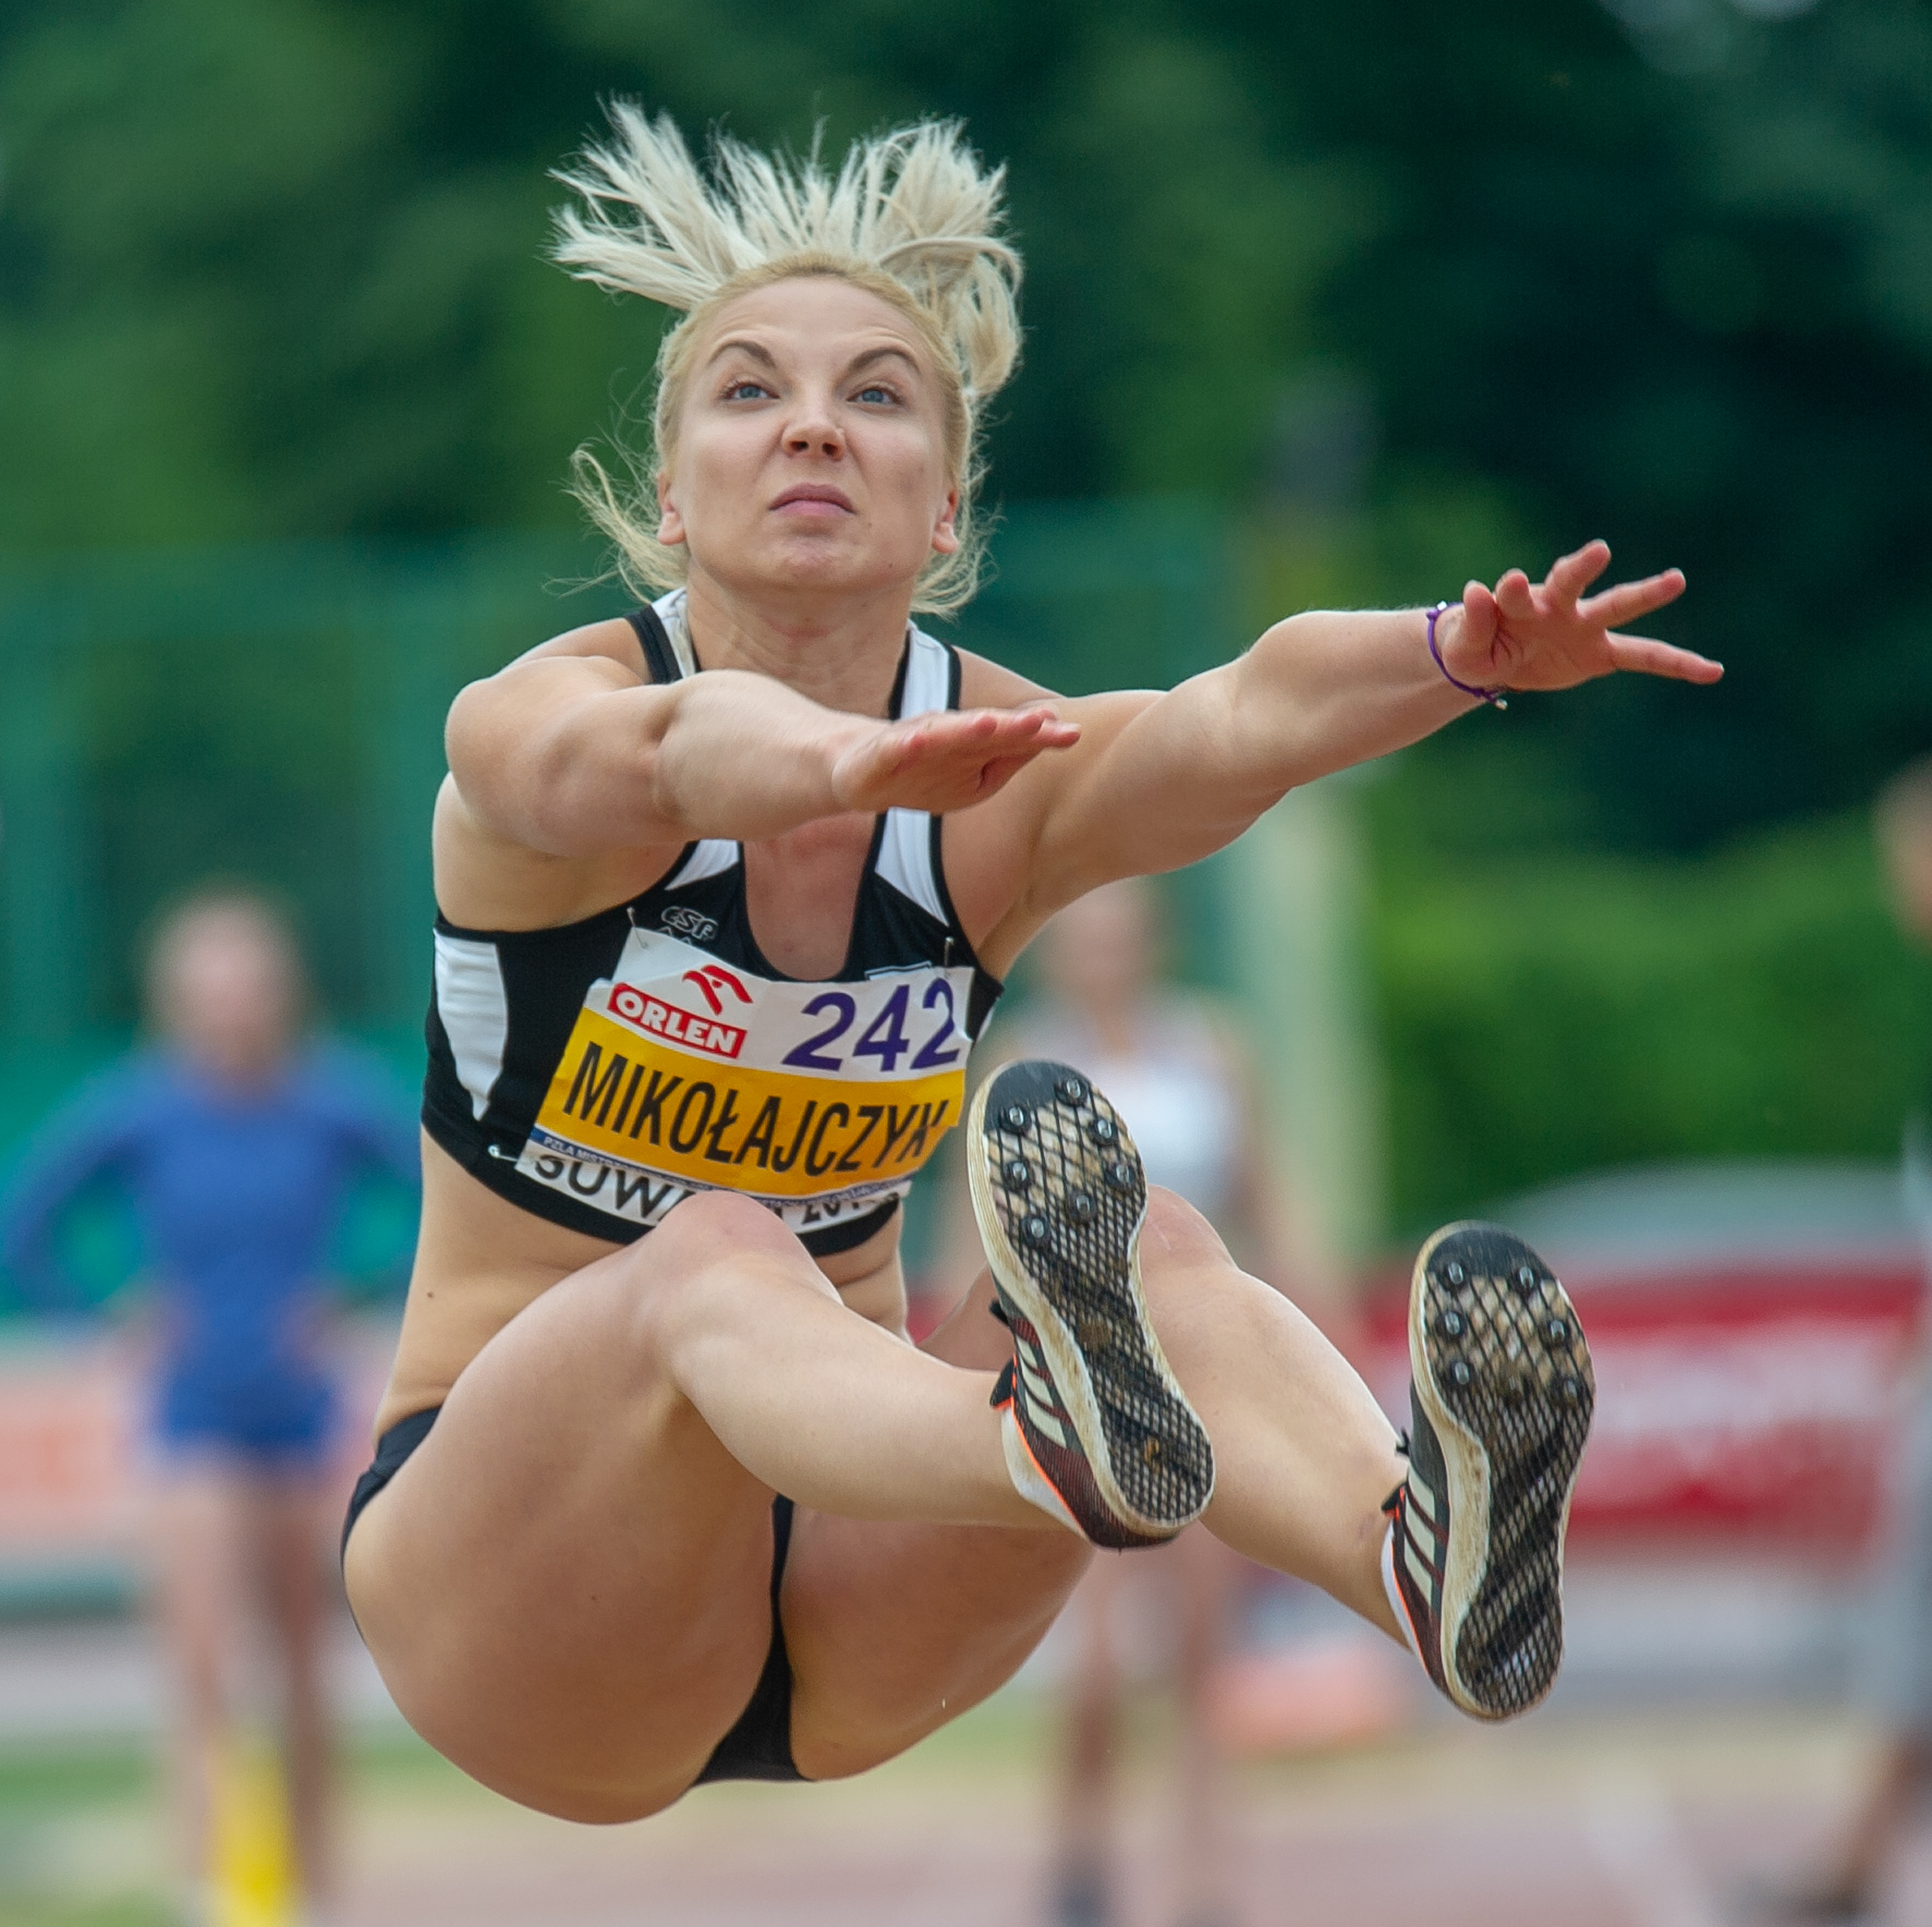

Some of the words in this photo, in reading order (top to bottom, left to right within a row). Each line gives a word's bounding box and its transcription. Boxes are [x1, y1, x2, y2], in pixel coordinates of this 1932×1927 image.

[616, 991, 737, 1054] ORLEN
[781, 977, 960, 1072] 242
[562, 1041, 949, 1176] MIKOŁAJCZYK
